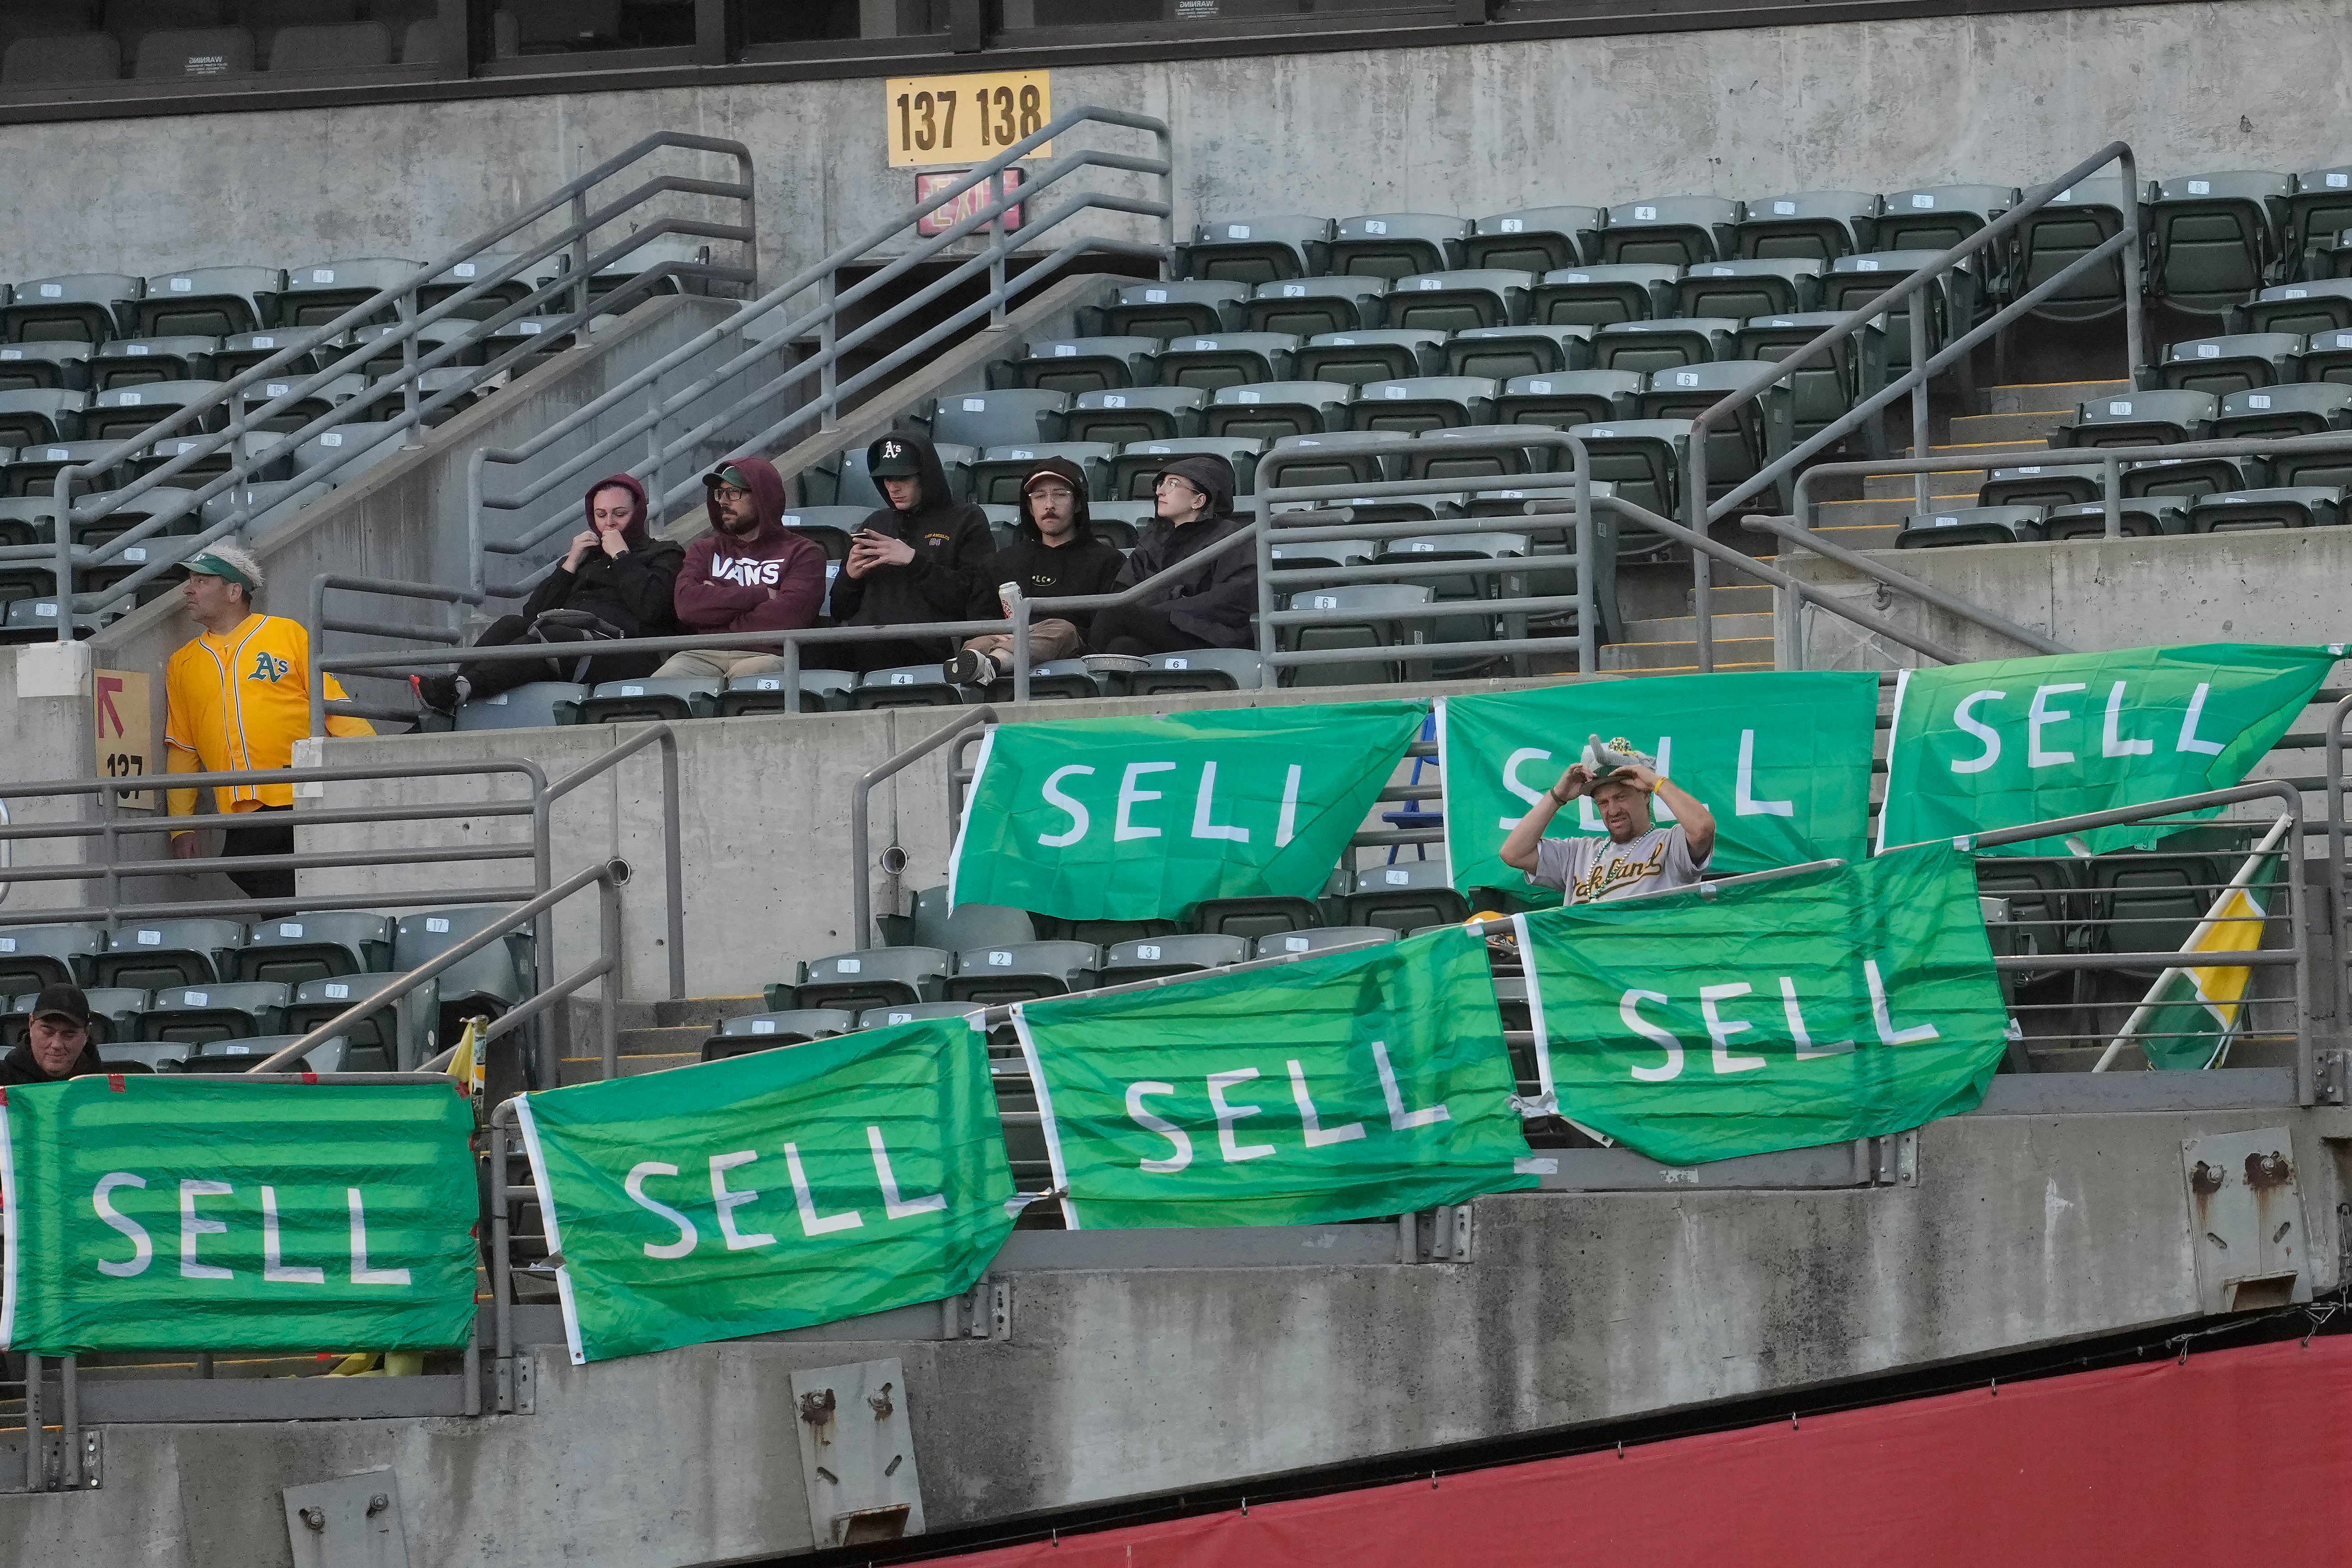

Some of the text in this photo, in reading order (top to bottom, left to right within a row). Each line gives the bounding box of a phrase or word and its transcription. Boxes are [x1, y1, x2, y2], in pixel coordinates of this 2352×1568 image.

[897, 84, 1041, 151] 137 138
[2334, 175, 2340, 185] 9
[2196, 182, 2202, 193] 8
[1920, 197, 1926, 206] 6
[1642, 208, 1648, 218] 4
[1373, 222, 1379, 232] 2
[1509, 220, 1514, 231] 3
[1428, 281, 1434, 290] 3
[1292, 287, 1297, 296] 2
[1204, 342, 1210, 350] 2
[2205, 346, 2213, 356] 10
[1684, 375, 1690, 385] 6
[273, 386, 282, 396] 15
[1393, 388, 1399, 398] 4
[1111, 397, 1118, 407] 2
[2256, 397, 2264, 407] 11
[2116, 403, 2126, 413] 10
[327, 435, 336, 445] 16
[882, 441, 902, 459] A's
[712, 552, 785, 587] VANS
[832, 567, 838, 578] 2
[1036, 575, 1047, 583] LC
[1322, 598, 1328, 608] 6
[41, 605, 50, 615] 16
[247, 651, 289, 683] A's
[899, 676, 905, 684] 4
[1951, 680, 2226, 774] SELL
[1573, 842, 1664, 898] akland
[1394, 872, 1399, 883] 4
[433, 920, 442, 931] 17
[145, 932, 154, 943] 15
[1146, 947, 1151, 958] 3
[998, 954, 1004, 964] 2
[332, 986, 342, 997] 17
[897, 1015, 903, 1024] 2
[1618, 959, 1941, 1084] SELL
[1125, 1041, 1452, 1174] SELL
[624, 1126, 948, 1260] SELL
[92, 1172, 411, 1286] SELL
